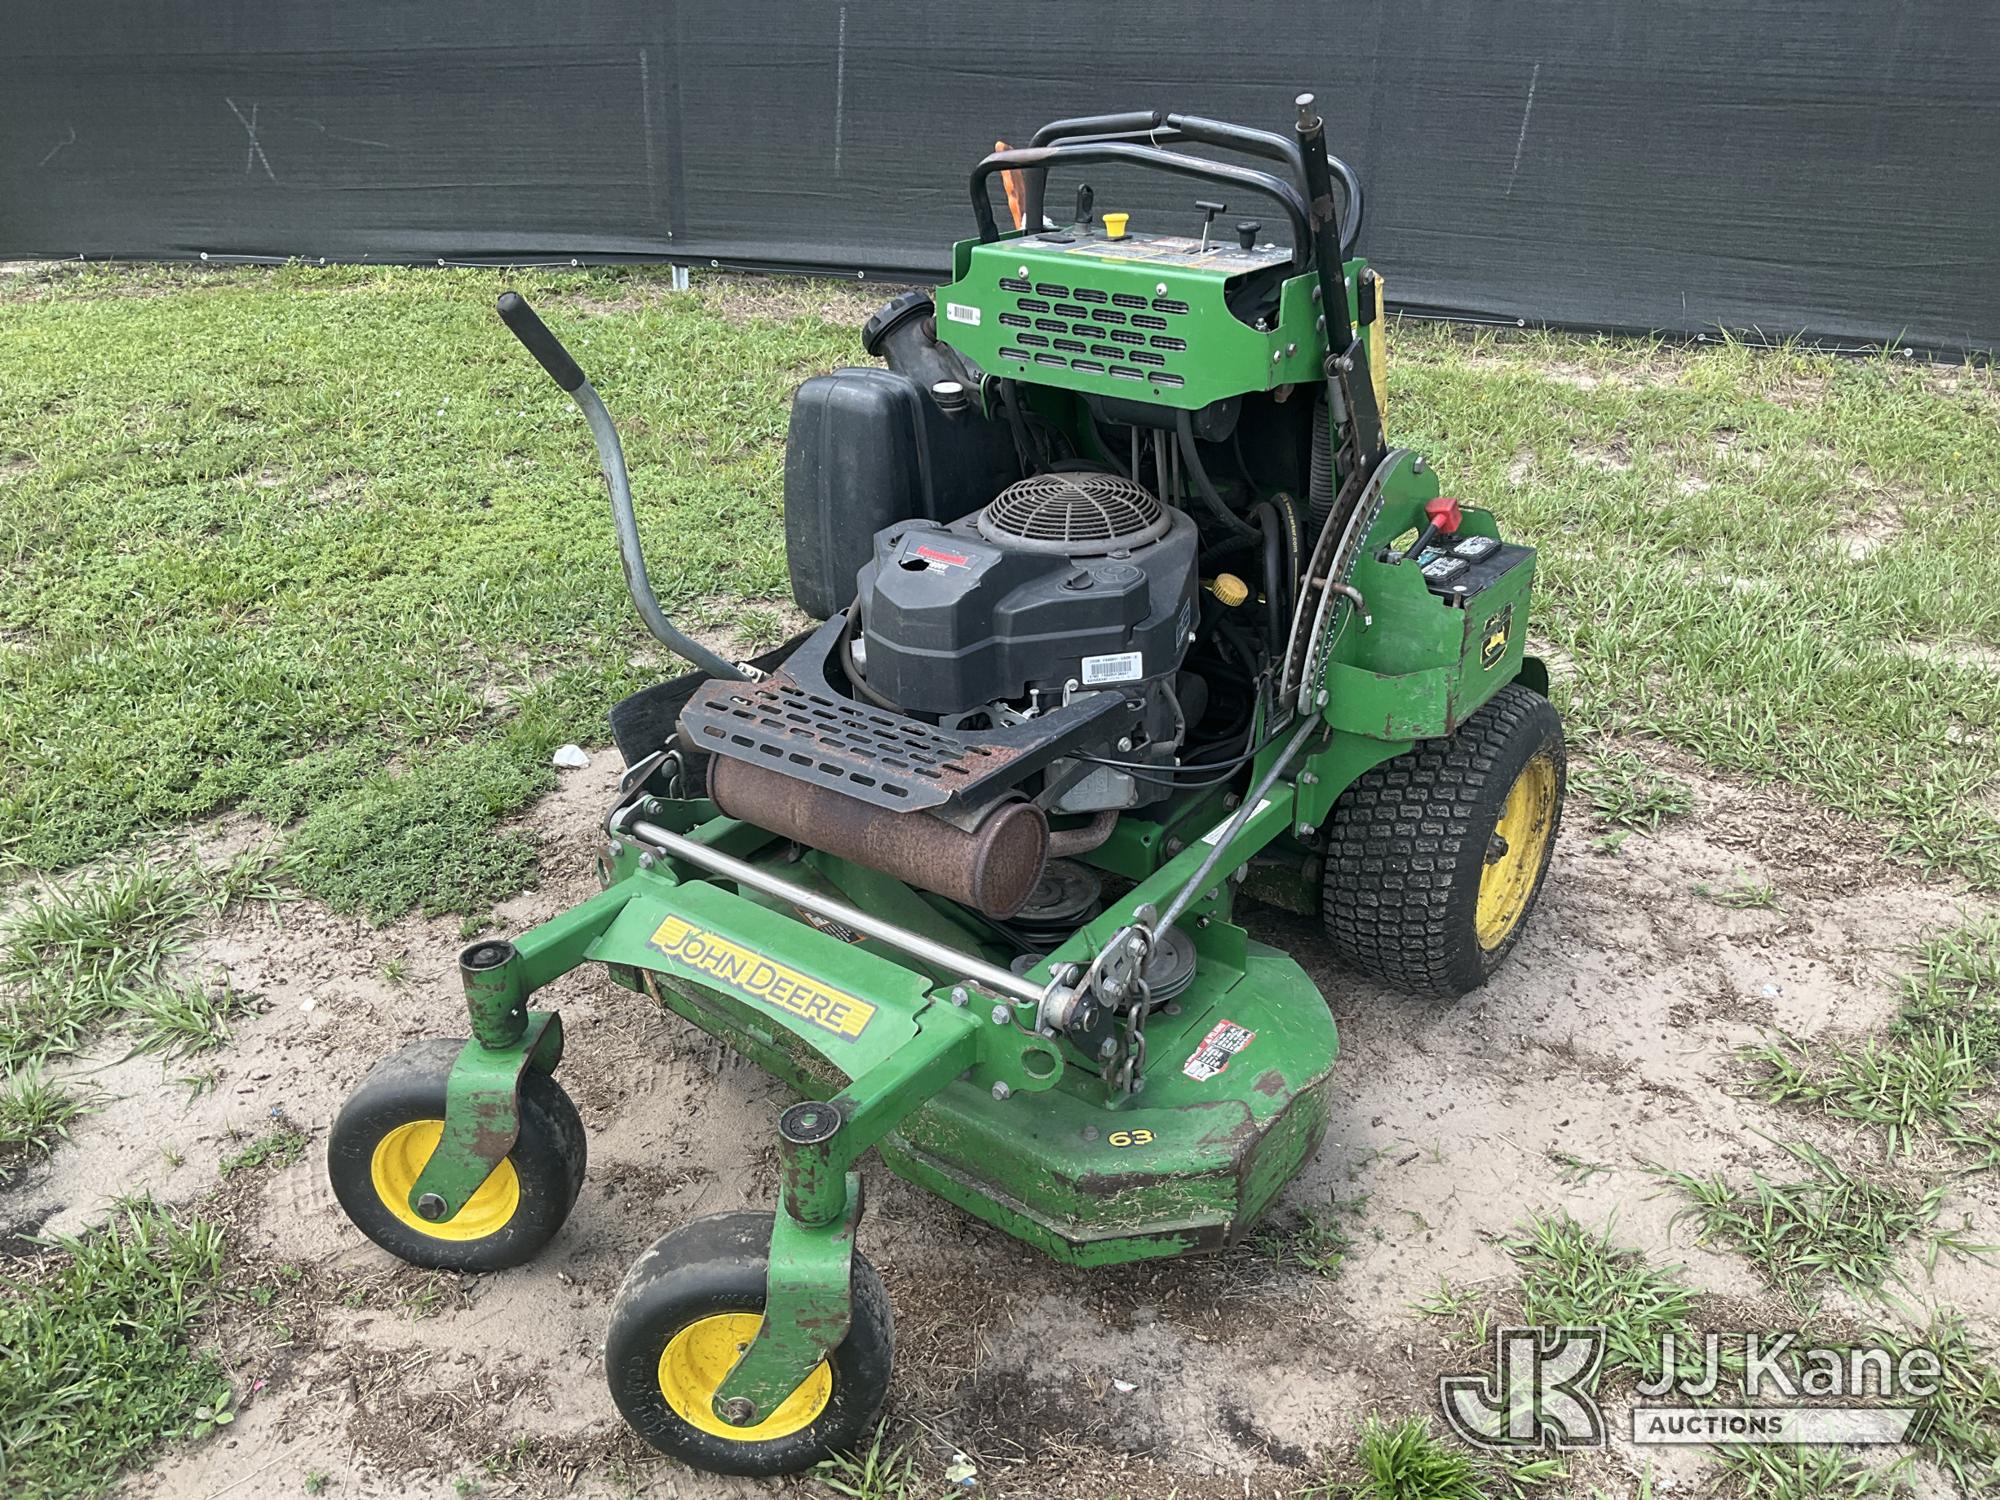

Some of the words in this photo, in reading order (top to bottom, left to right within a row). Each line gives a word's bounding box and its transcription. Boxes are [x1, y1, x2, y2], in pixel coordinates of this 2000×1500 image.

[665, 930, 748, 979] JOHN
[750, 962, 852, 1026] DEERE
[1108, 1129, 1154, 1147] 63
